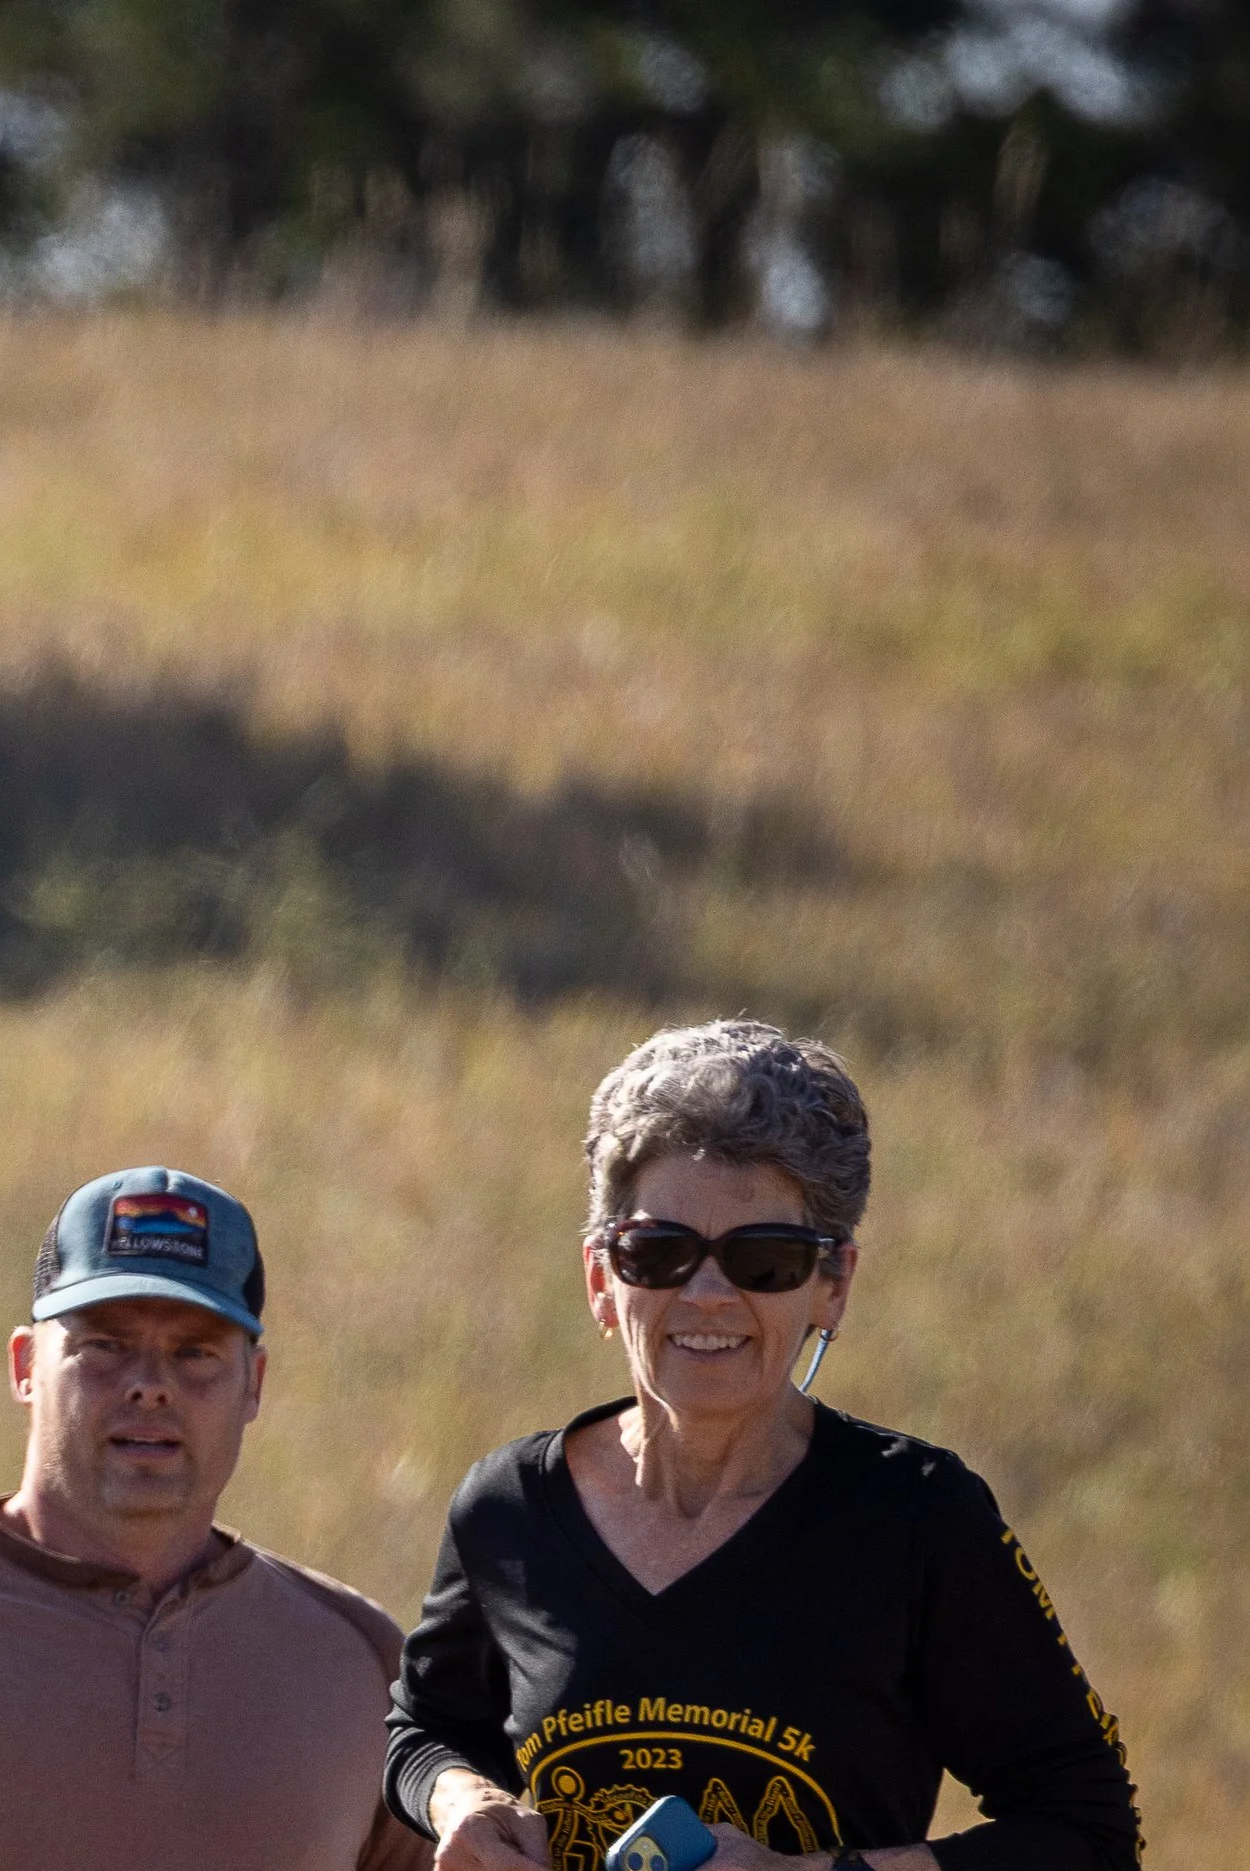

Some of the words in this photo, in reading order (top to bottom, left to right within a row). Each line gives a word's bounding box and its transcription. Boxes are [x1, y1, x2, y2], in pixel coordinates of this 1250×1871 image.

[542, 1699, 632, 1744] Pfeifle
[638, 1697, 778, 1743] Memorial
[777, 1725, 817, 1763] 5k
[619, 1748, 683, 1770] 2023
